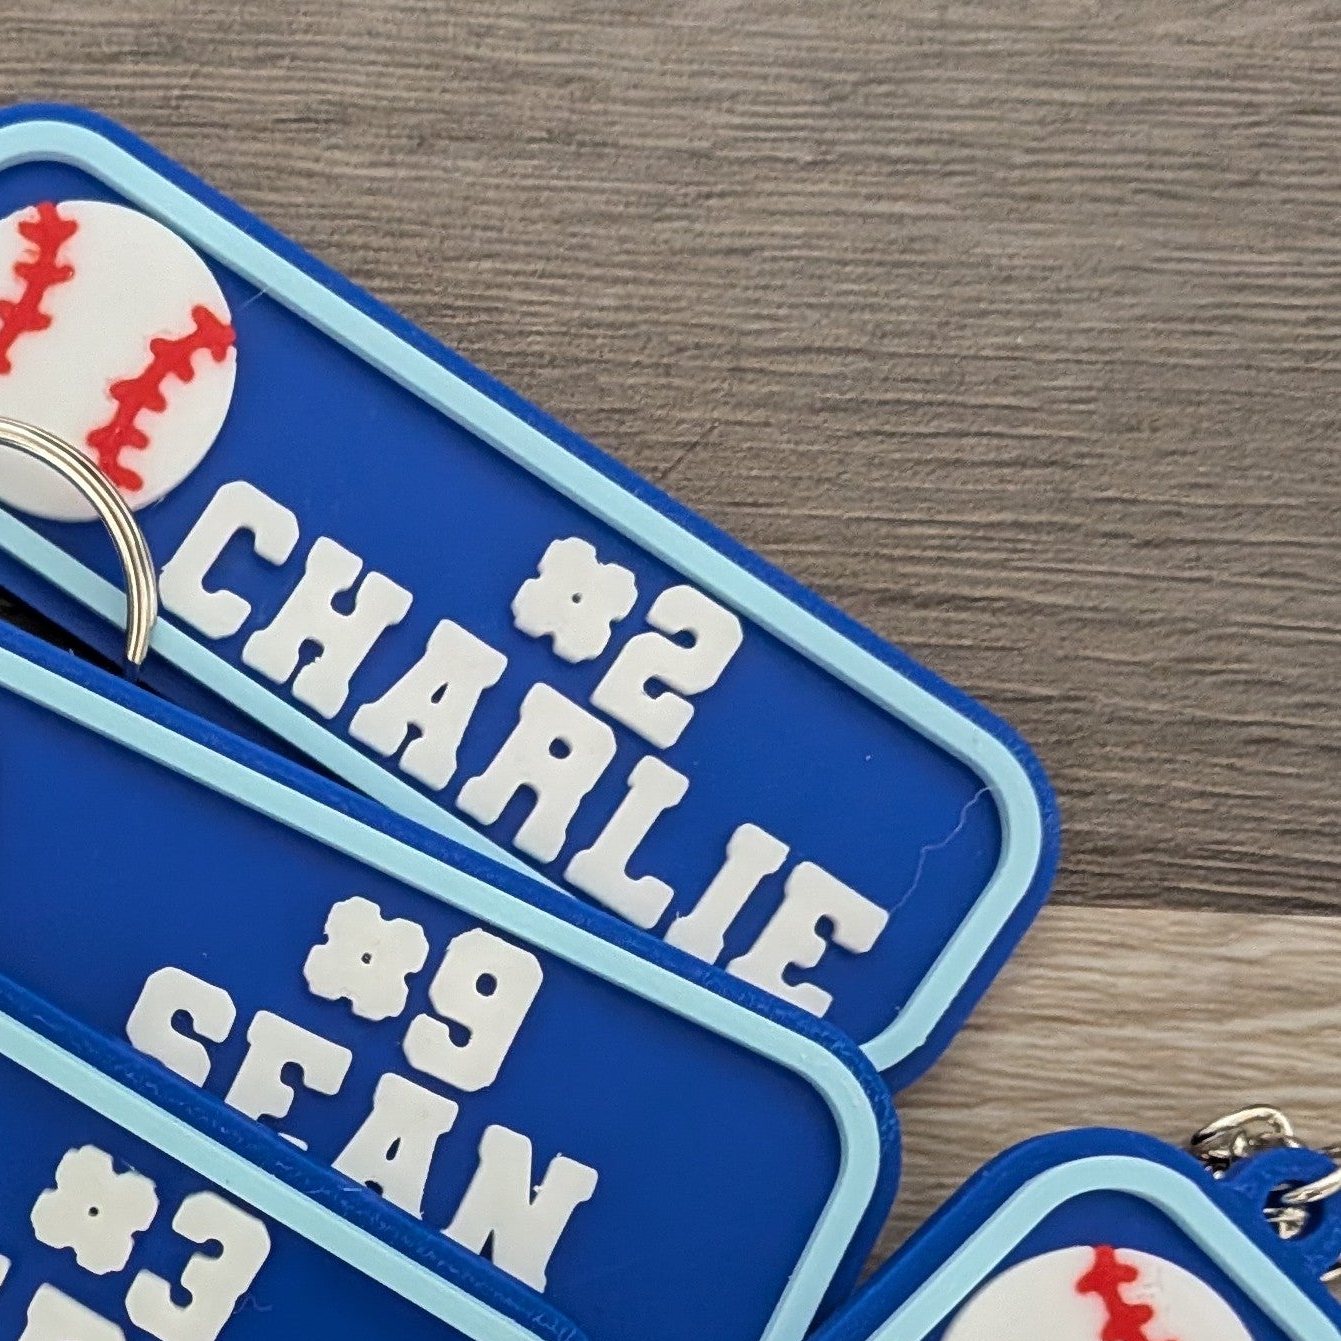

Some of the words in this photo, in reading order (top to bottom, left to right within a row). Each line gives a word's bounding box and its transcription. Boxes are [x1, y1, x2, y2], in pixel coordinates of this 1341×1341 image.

[158, 480, 889, 1017] CHARLIE
[512, 536, 744, 748] #2
[303, 896, 544, 1093] #9
[125, 966, 599, 1293] SEAN
